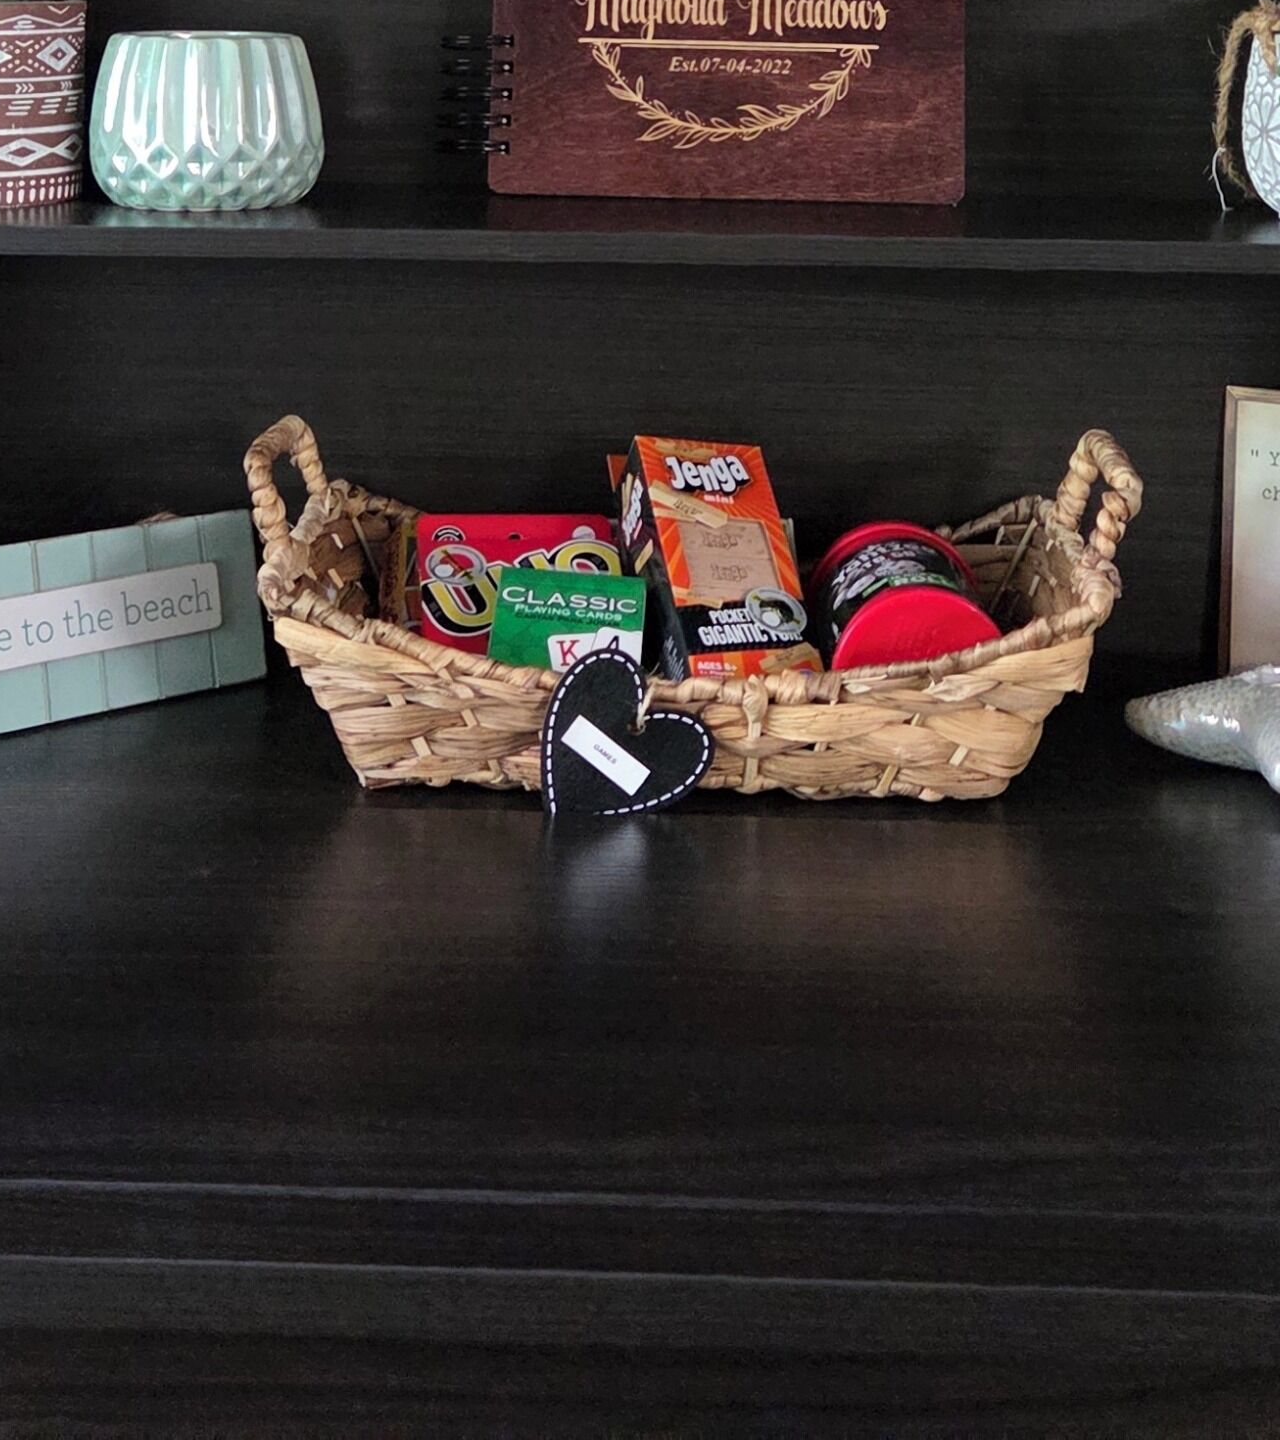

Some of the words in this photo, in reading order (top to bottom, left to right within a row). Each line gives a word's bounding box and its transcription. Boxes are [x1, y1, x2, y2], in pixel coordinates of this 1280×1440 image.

[665, 455, 750, 493] Jenga
[21, 618, 54, 648] to
[62, 600, 114, 639] the
[120, 578, 214, 627] beach
[502, 586, 637, 613] CLASSIC
[514, 603, 571, 617] PLAYING
[575, 609, 623, 621] CARDS
[697, 624, 769, 647] GIGANTIC
[556, 639, 580, 667] K
[593, 743, 618, 765] GAMES
